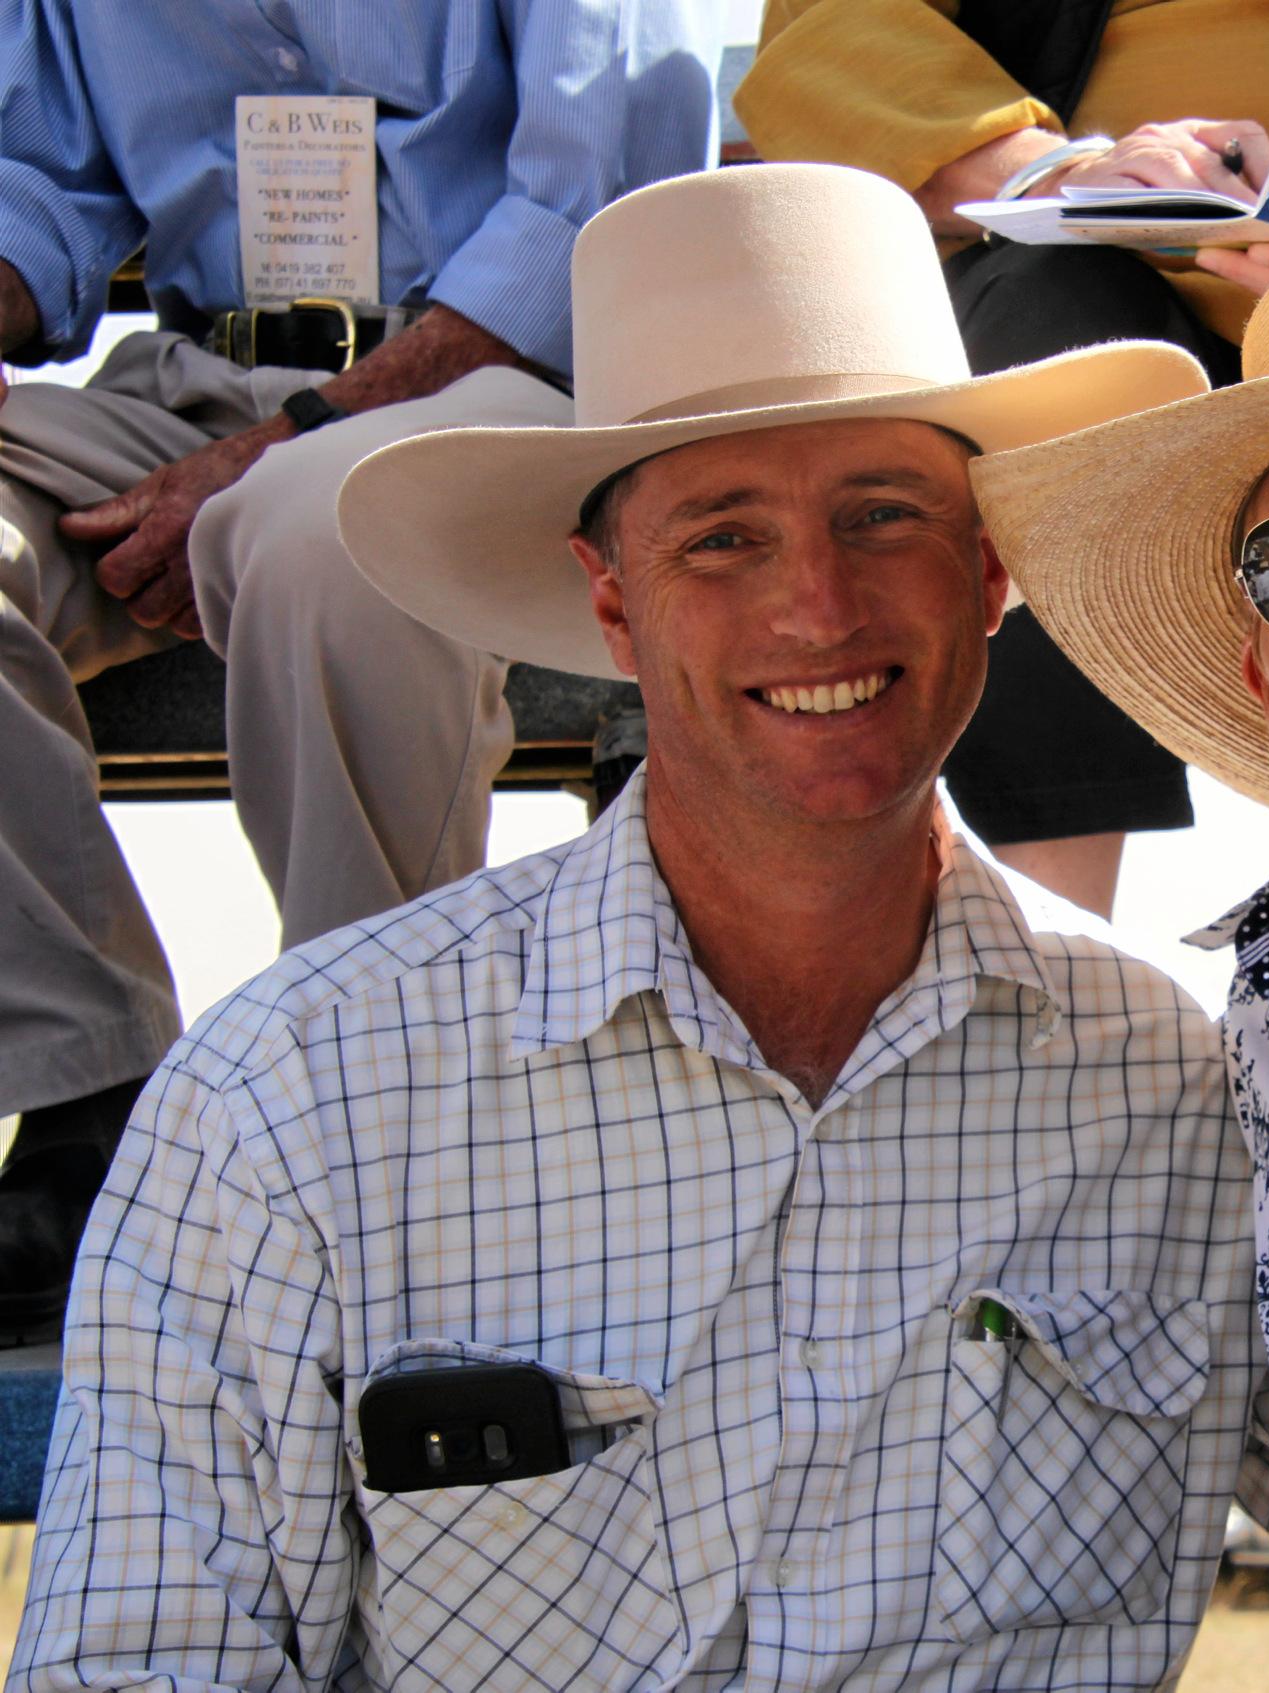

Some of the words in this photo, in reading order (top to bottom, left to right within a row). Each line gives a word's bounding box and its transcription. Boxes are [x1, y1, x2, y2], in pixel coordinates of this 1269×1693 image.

[247, 112, 263, 134] C
[268, 120, 281, 134] &
[288, 112, 301, 134] B
